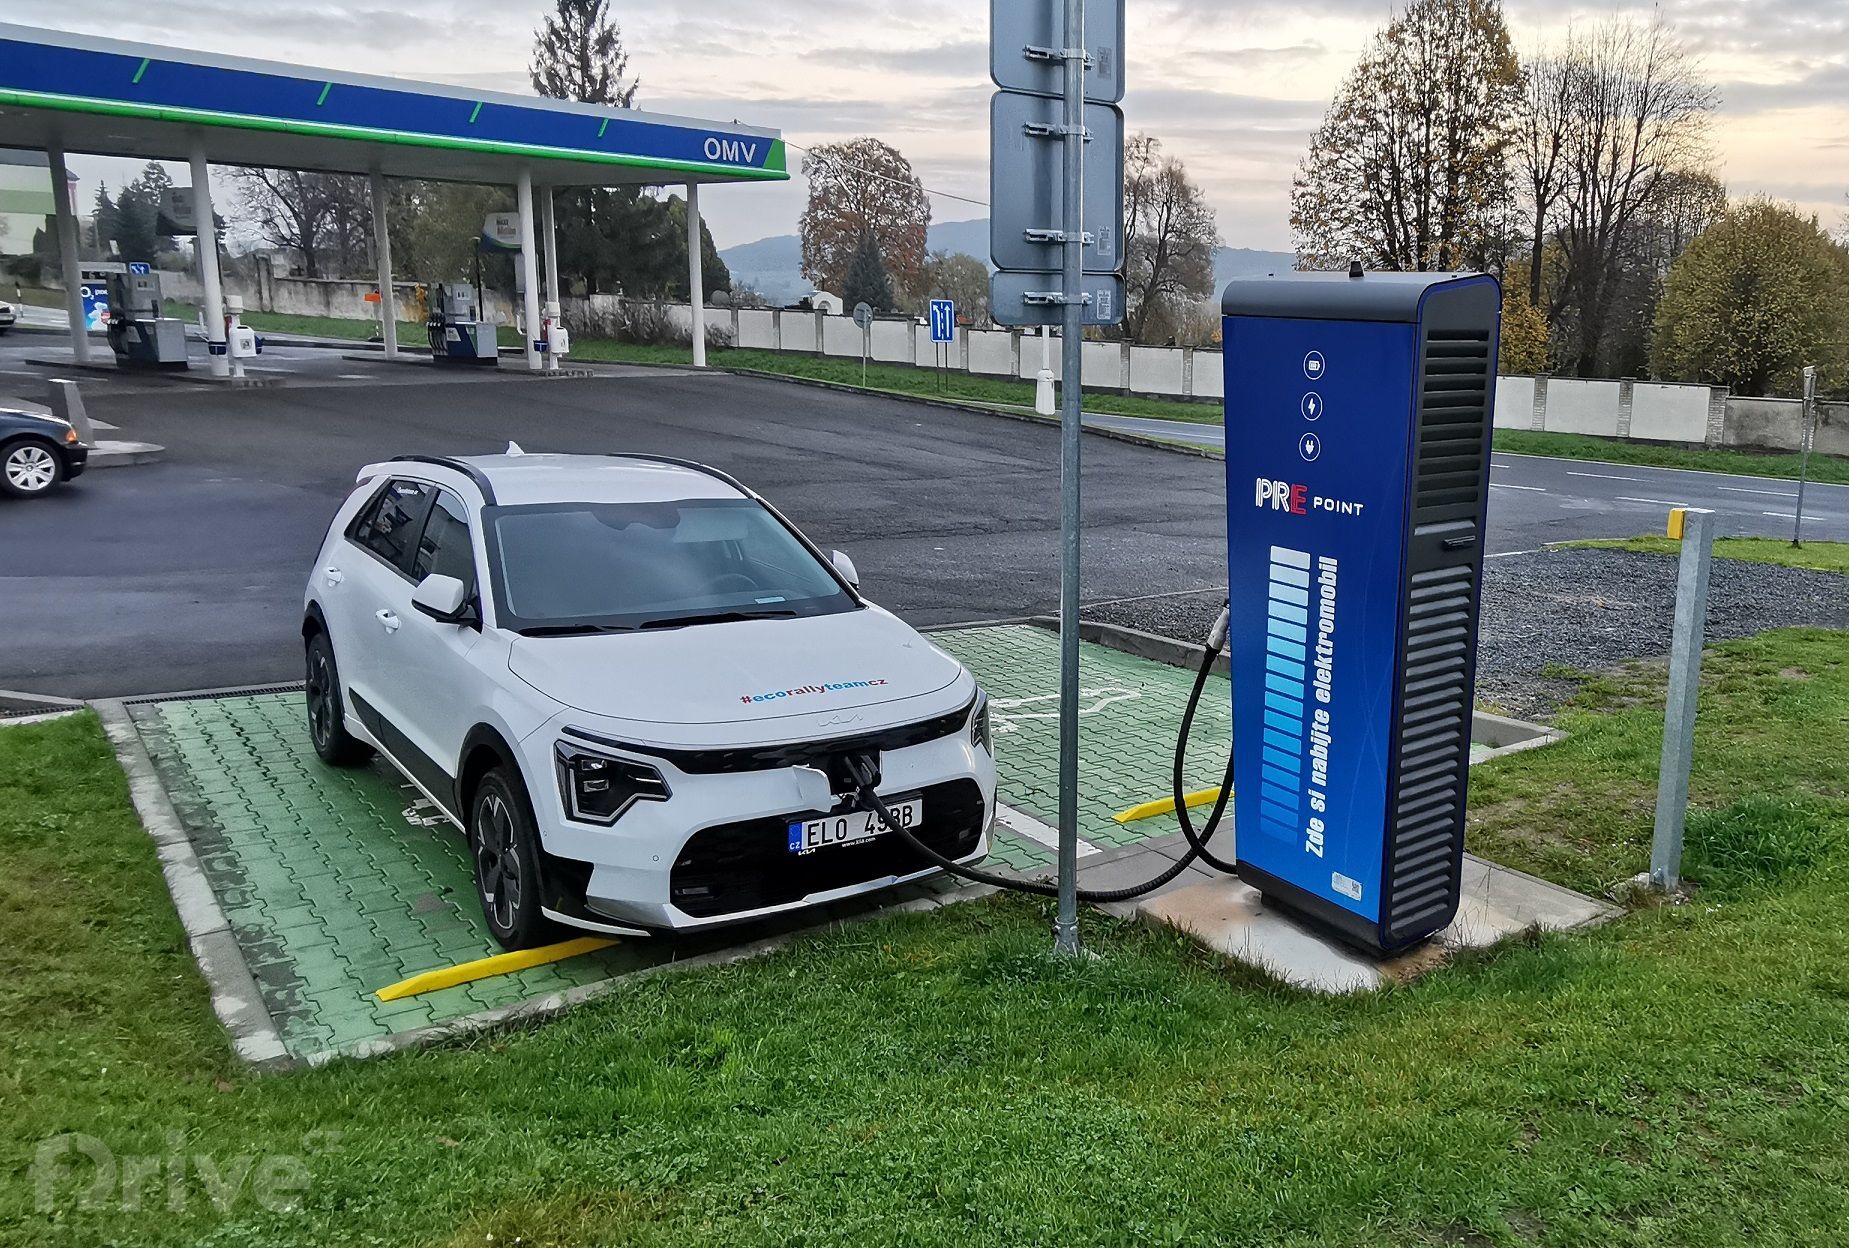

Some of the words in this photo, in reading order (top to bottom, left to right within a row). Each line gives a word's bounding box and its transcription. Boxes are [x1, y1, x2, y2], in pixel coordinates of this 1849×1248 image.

[704, 137, 757, 163] OMV
[1255, 477, 1308, 515] PRE
[1313, 496, 1364, 516] POINT
[1312, 555, 1338, 704] elektromobil
[740, 678, 888, 704] #ecorallyteamcz
[1310, 708, 1331, 787] nabijte
[1308, 789, 1326, 812] si
[789, 841, 800, 850] CZ
[1305, 817, 1325, 858] Zde
